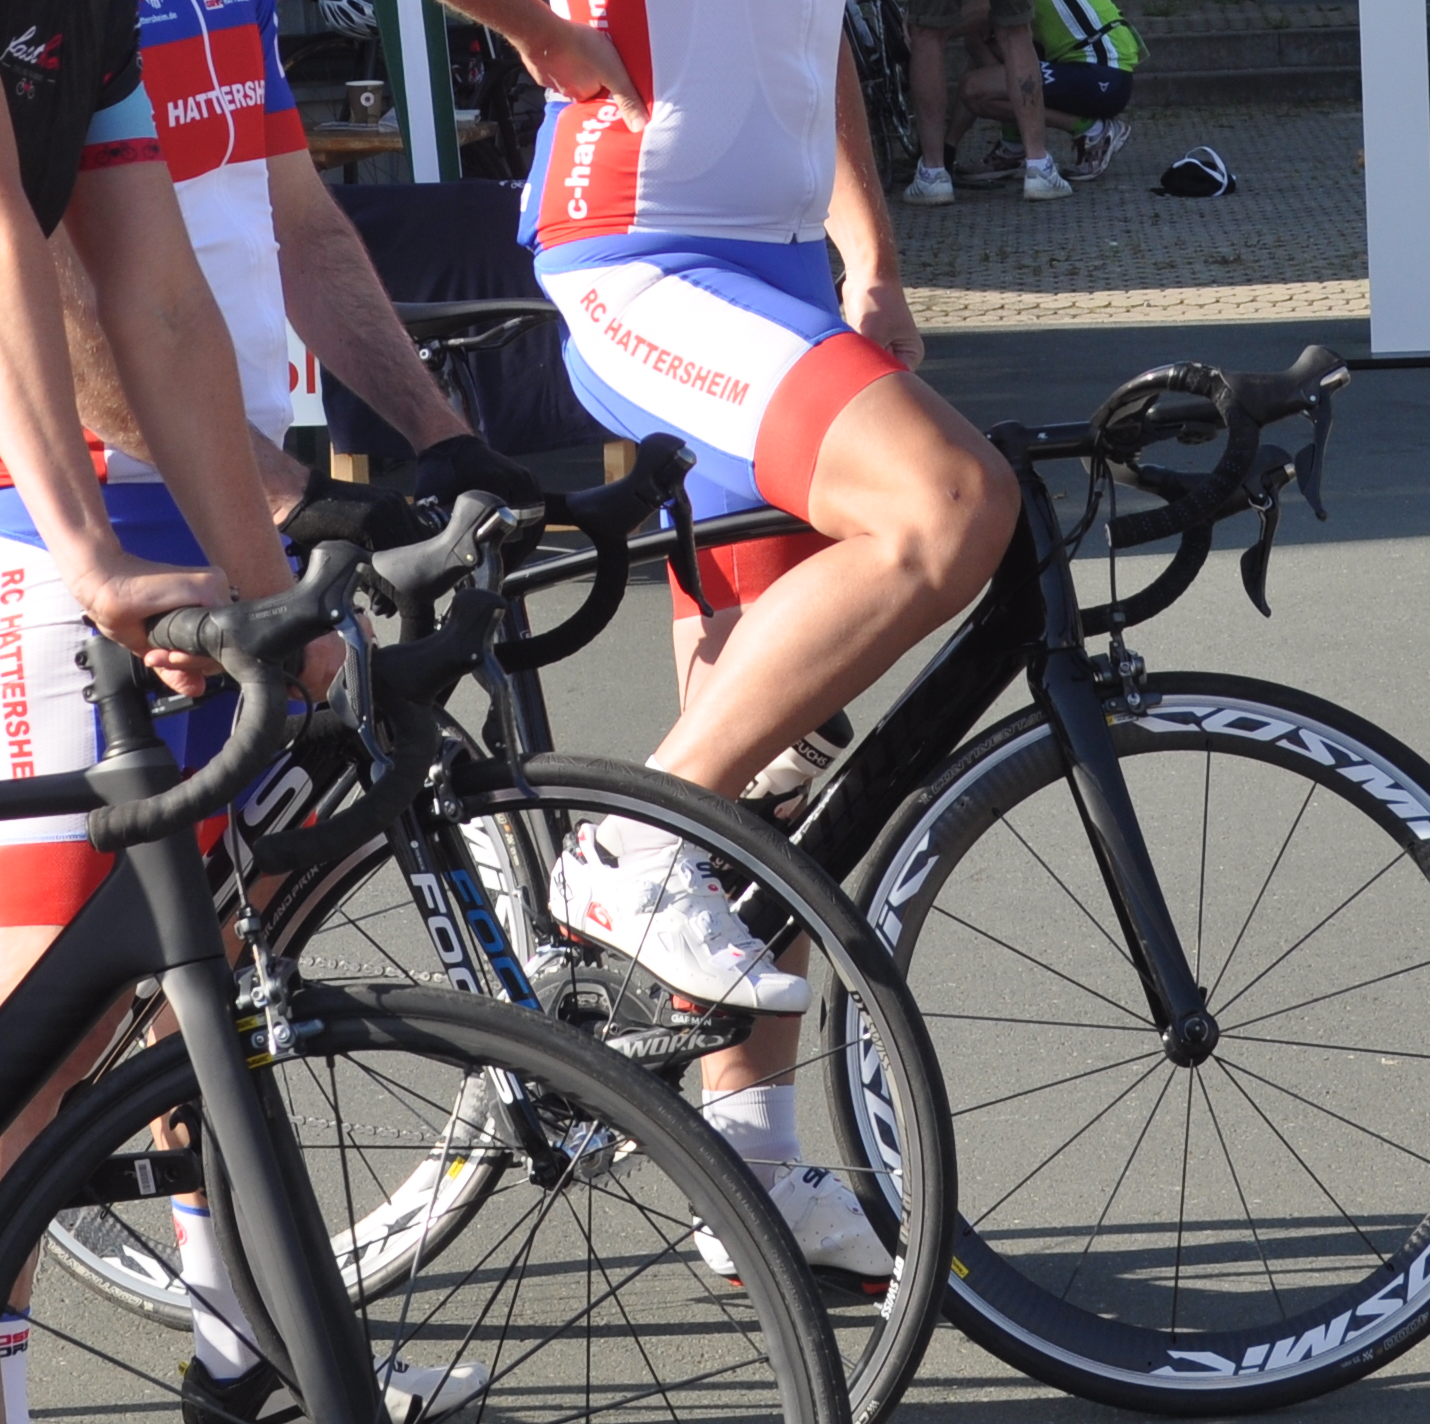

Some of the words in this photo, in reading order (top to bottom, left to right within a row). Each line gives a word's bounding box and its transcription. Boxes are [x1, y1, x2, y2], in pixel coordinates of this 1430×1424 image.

[579, 287, 607, 324] RC
[604, 318, 751, 408] HATTERSHEIM
[0, 567, 26, 606] RC
[793, 740, 829, 767] FUCHS
[893, 1254, 905, 1279] DT
[881, 1279, 900, 1321] SWISS
